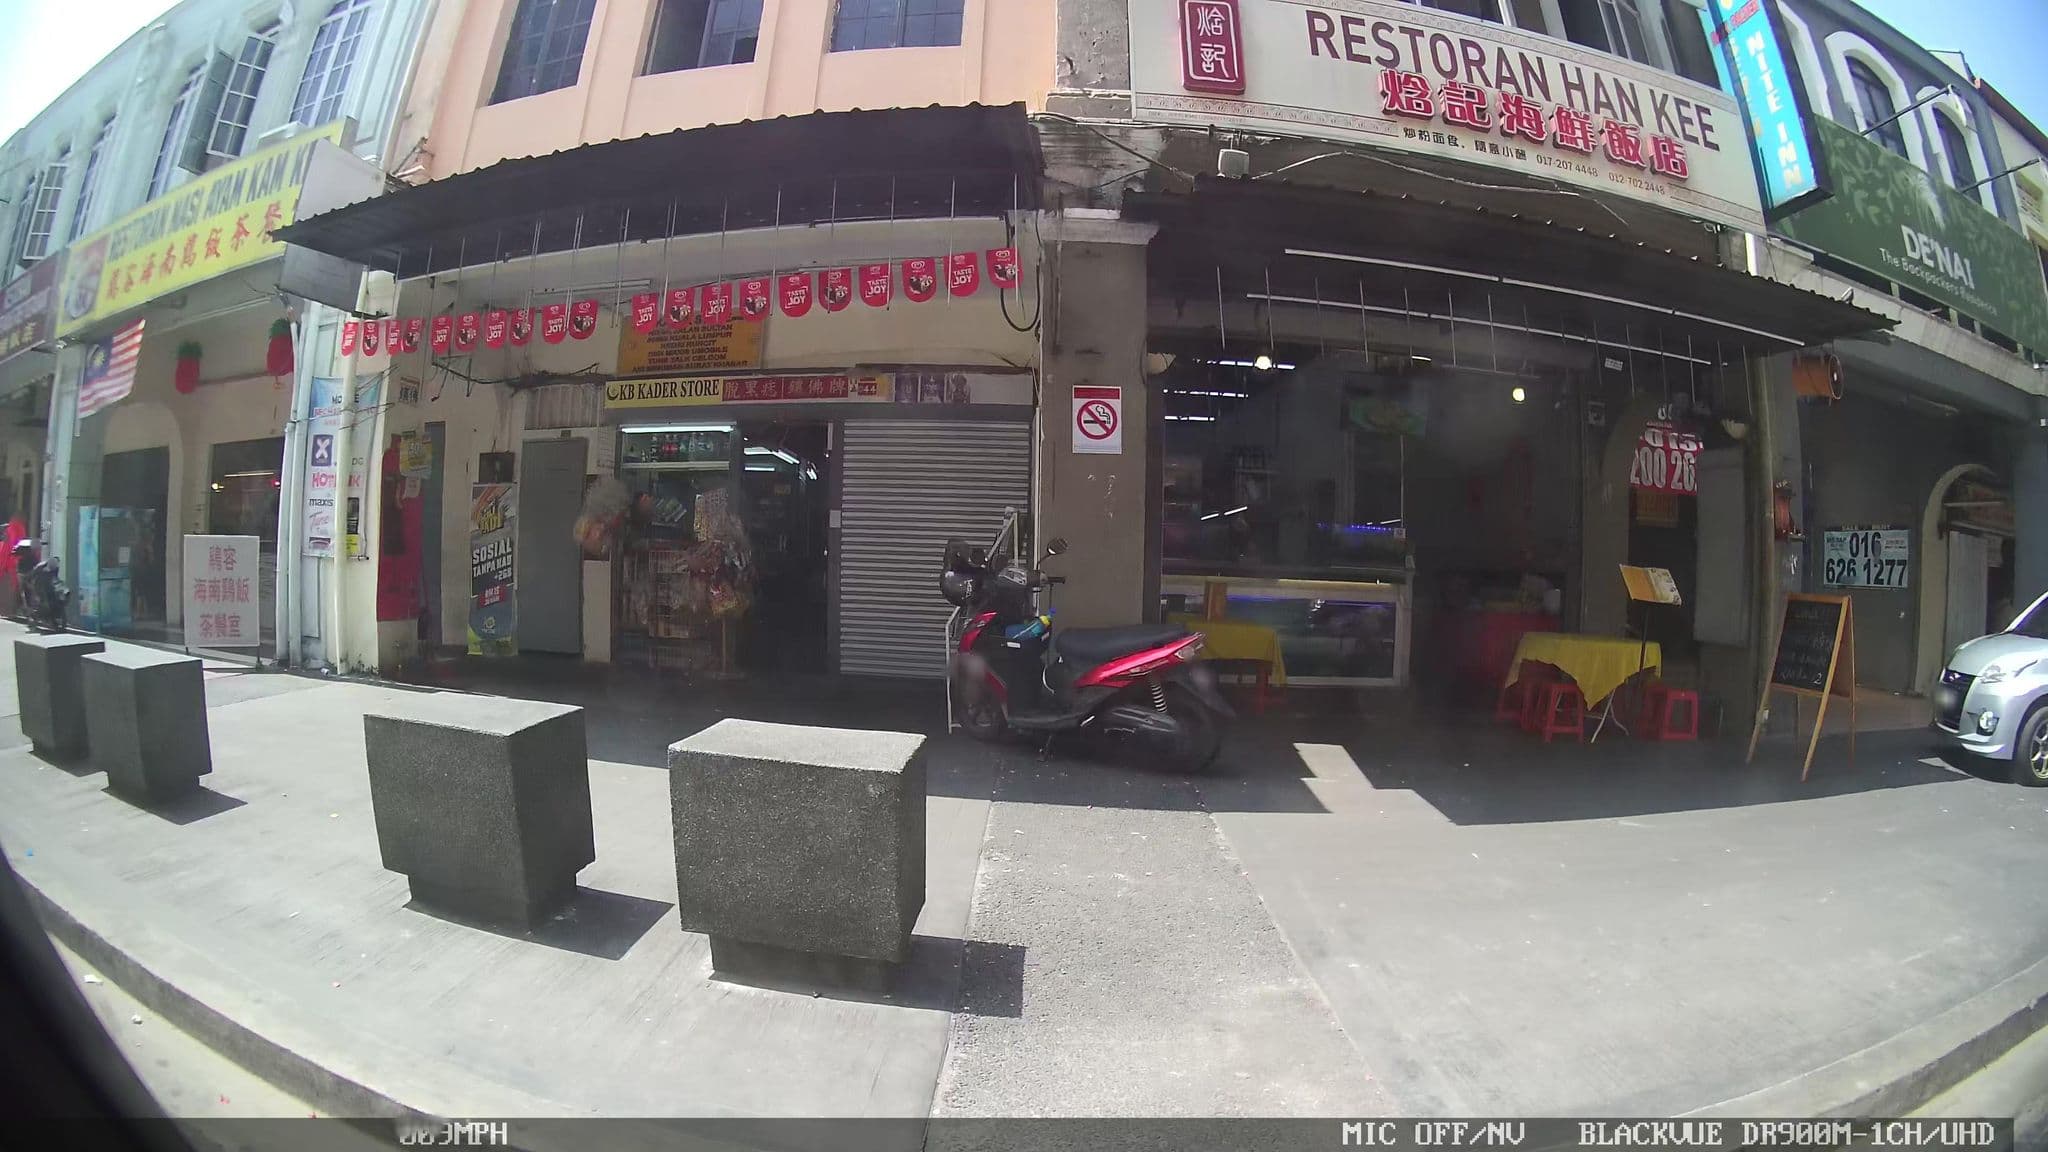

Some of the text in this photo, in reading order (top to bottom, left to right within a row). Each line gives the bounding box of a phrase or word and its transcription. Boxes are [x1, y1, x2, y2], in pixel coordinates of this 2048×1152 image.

[1306, 10, 1721, 152] RESTORAN HAN KEE
[1777, 121, 1804, 190] INN
[246, 151, 290, 203] KAM
[1879, 247, 1900, 267] The
[953, 269, 972, 277] TASTE
[953, 275, 973, 285] JOY
[786, 290, 806, 298] TASTE
[787, 296, 806, 306] JOY
[867, 286, 887, 296] JOY
[708, 299, 726, 307] TASTE
[708, 306, 726, 315] JOY
[619, 379, 720, 401] KB KADER STORE
[472, 537, 512, 566] SOSIAL
[1849, 531, 1882, 558] 016
[1826, 558, 1908, 587] 626 1277
